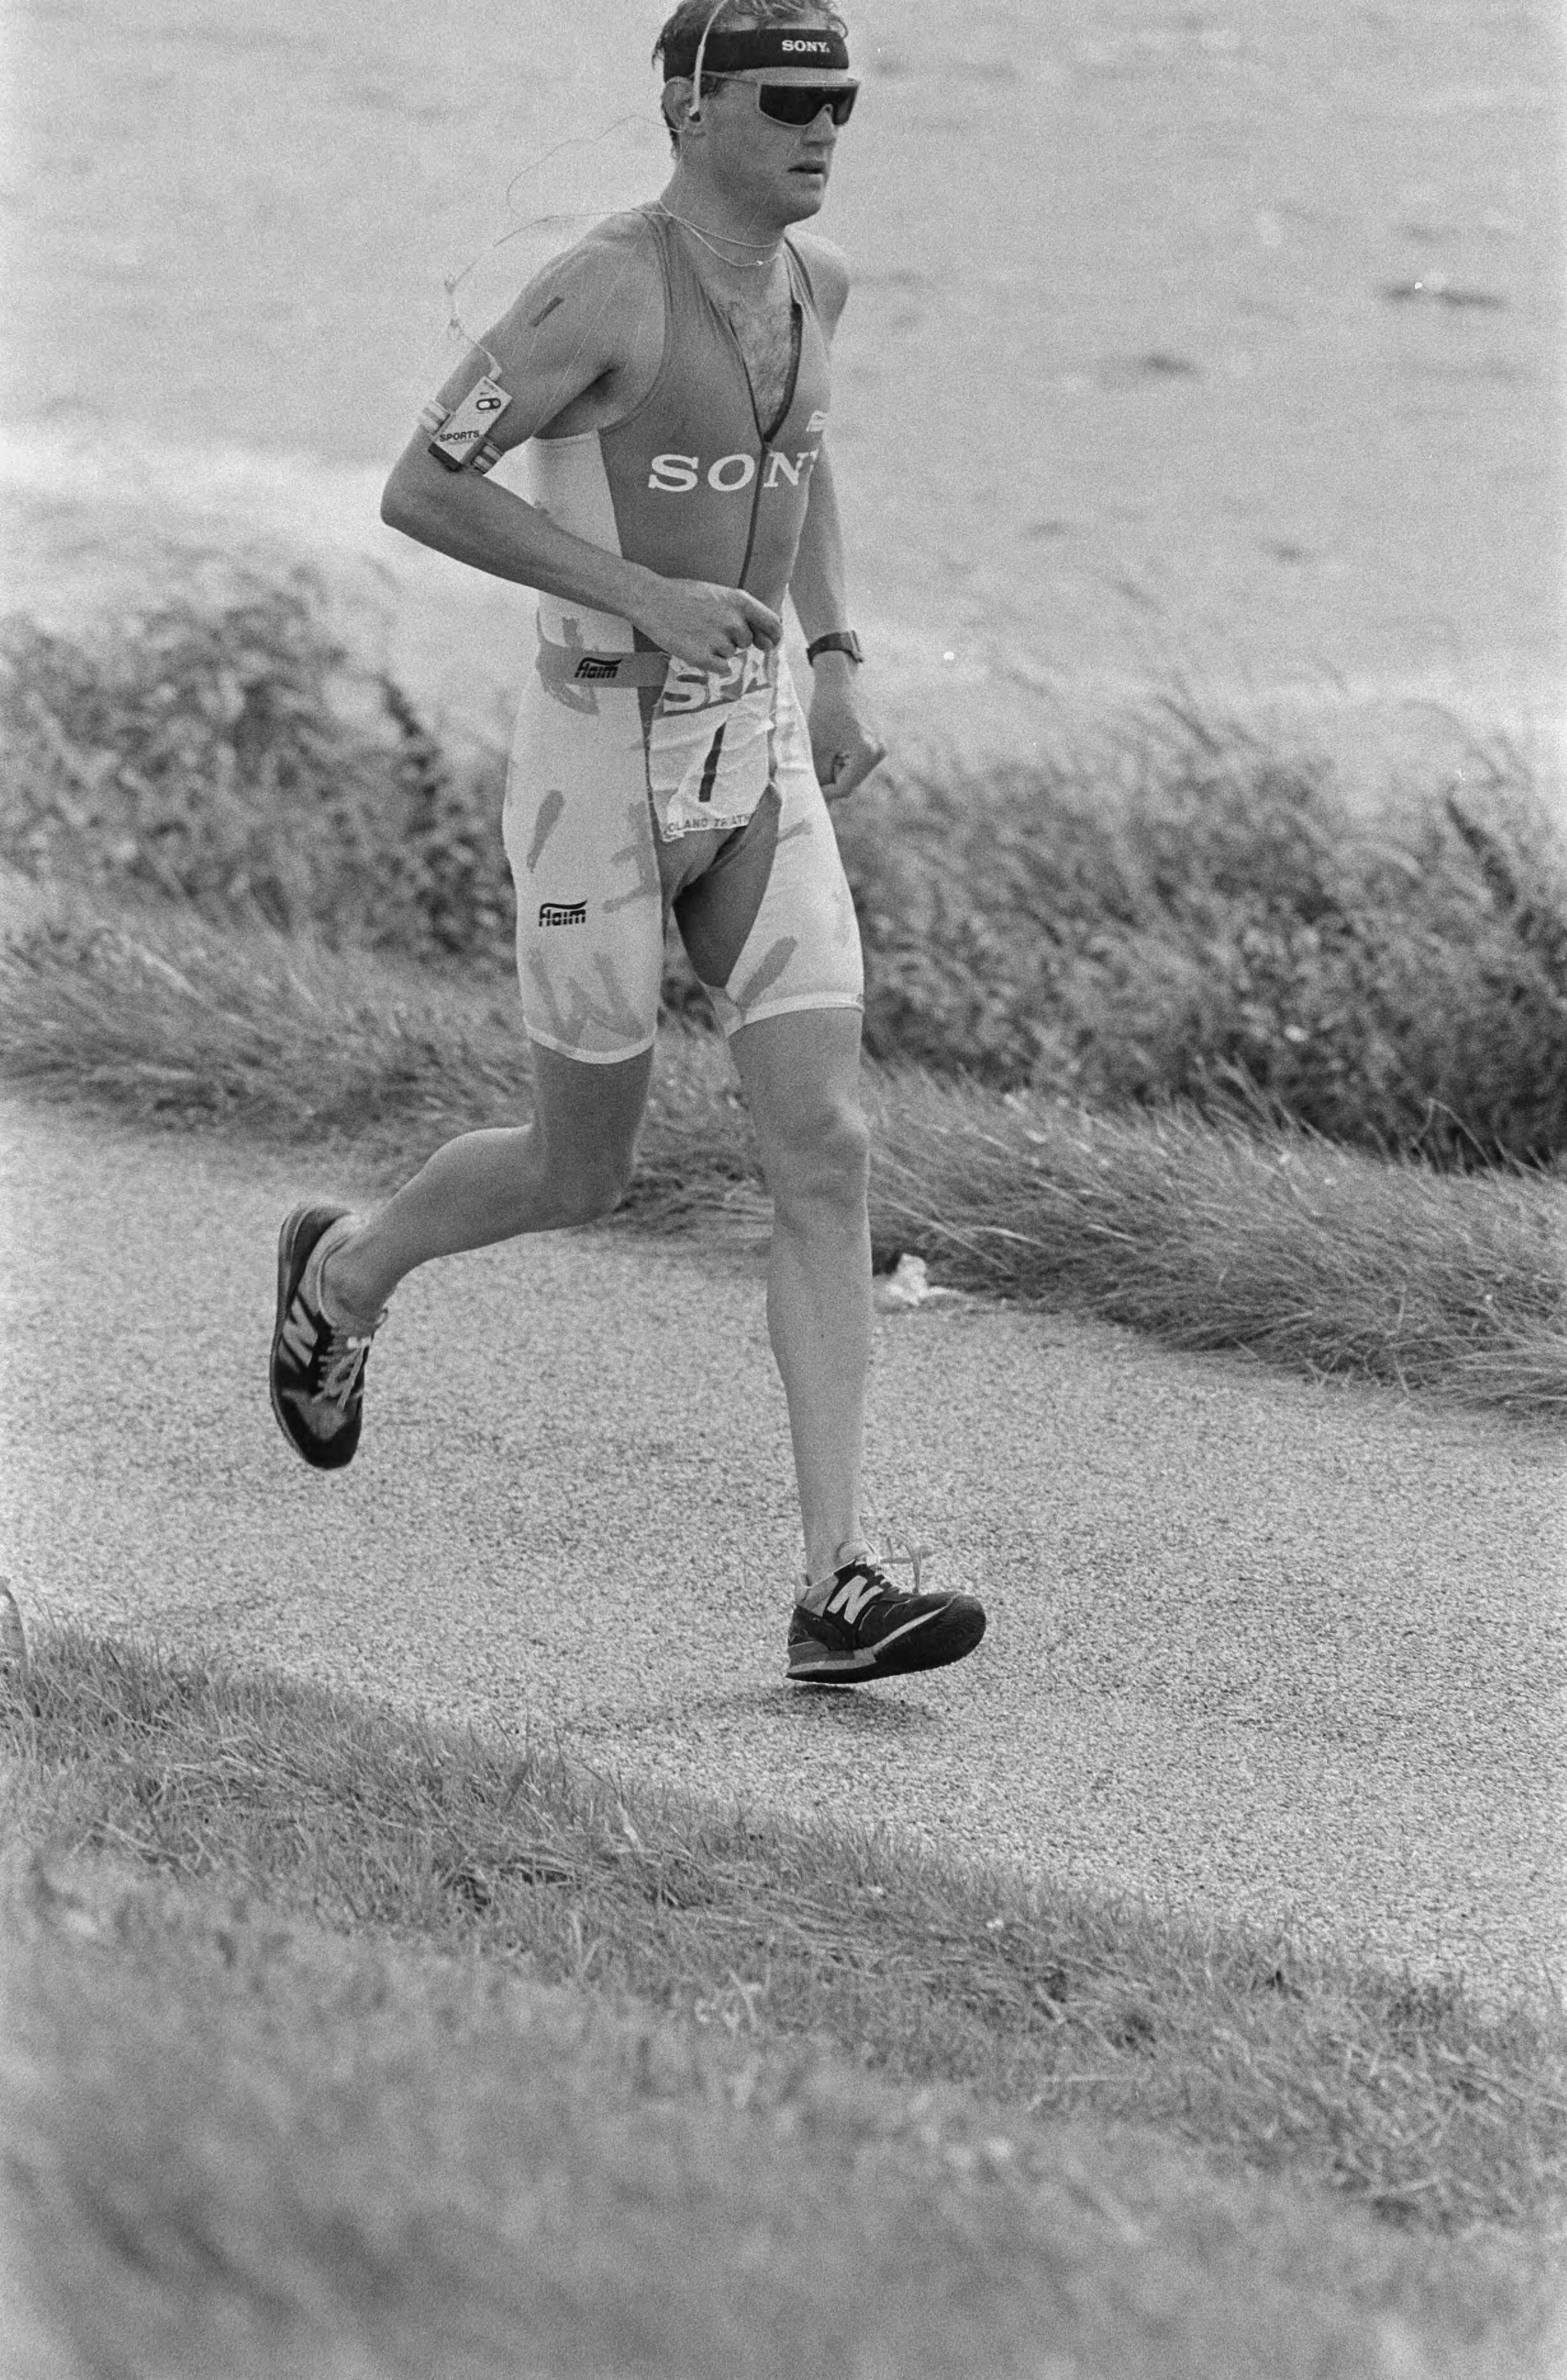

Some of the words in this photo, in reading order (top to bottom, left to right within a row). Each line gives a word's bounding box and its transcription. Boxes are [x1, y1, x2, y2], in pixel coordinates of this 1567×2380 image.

[782, 39, 830, 53] SONY
[439, 430, 480, 442] SPORTS
[698, 720, 727, 803] 1
